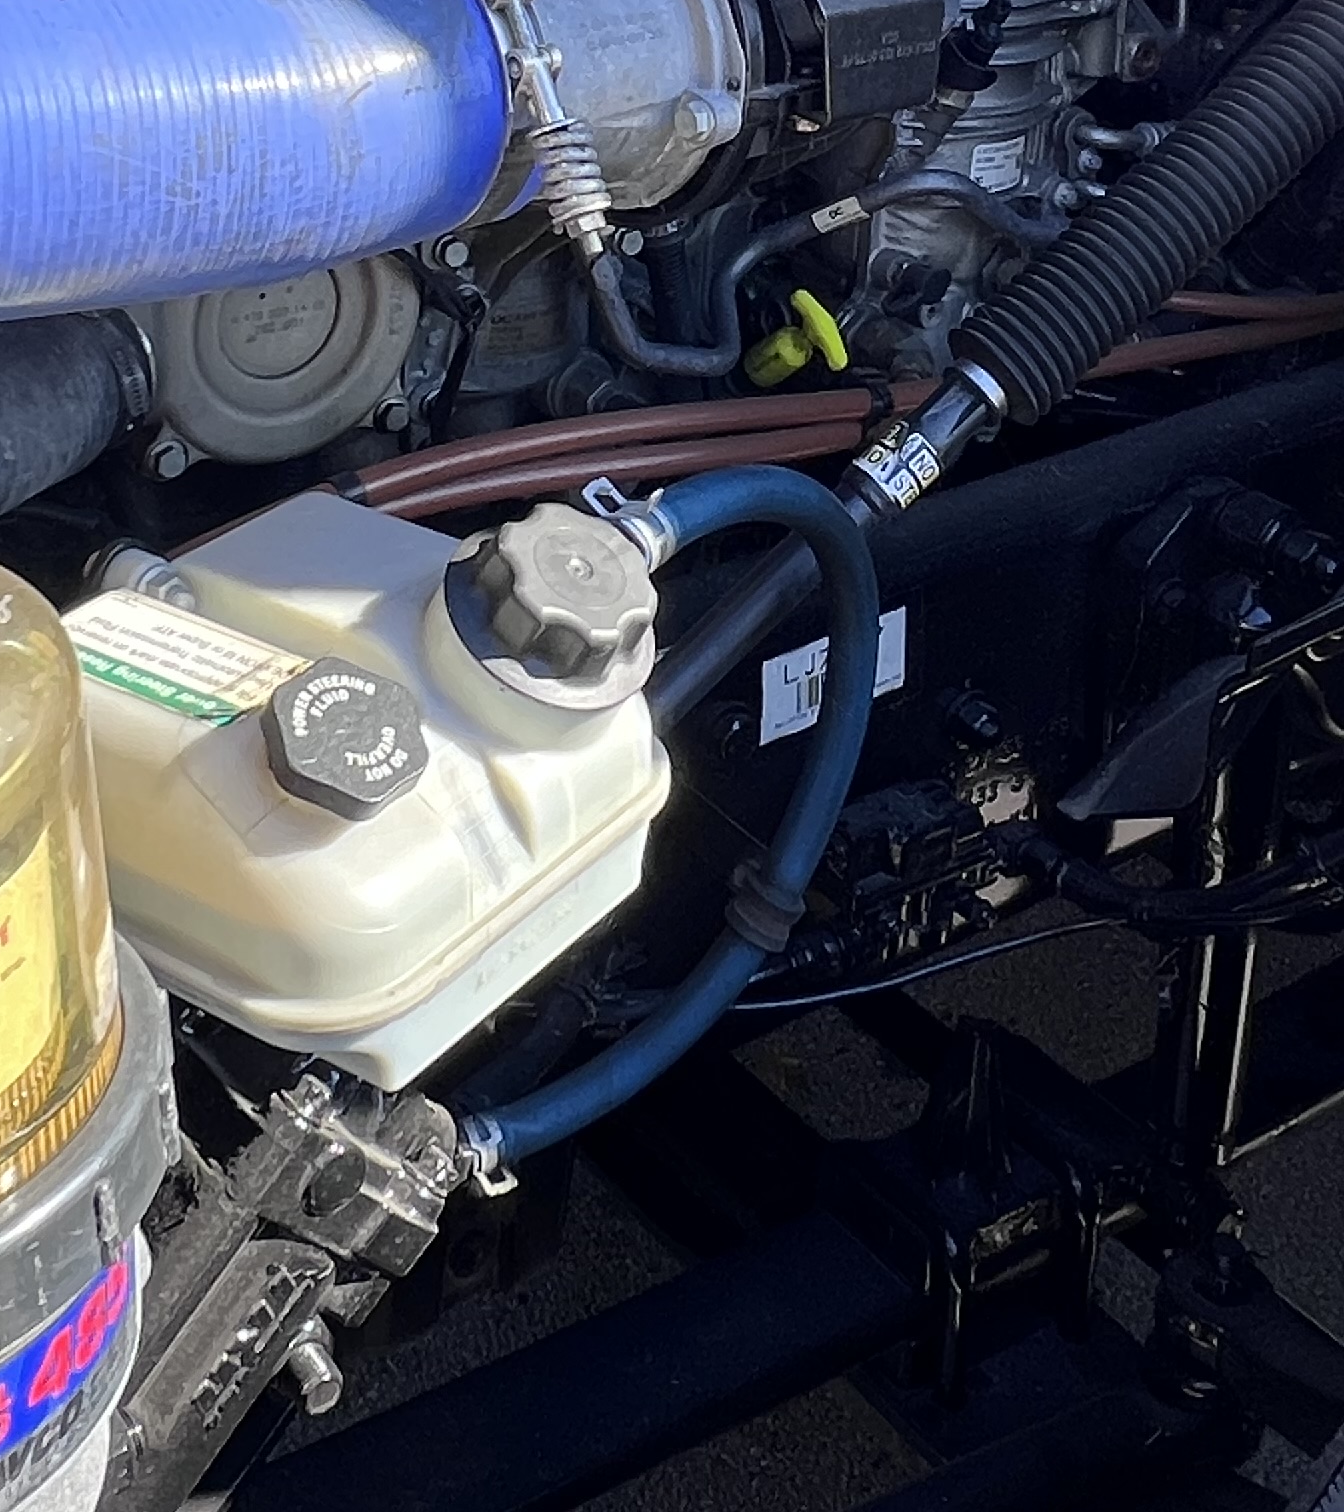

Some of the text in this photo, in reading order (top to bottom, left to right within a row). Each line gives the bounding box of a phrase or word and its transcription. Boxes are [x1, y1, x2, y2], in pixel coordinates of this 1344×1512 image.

[112, 665, 177, 700] Steering
[292, 674, 376, 738] POWER STEERING
[309, 688, 350, 718] FLUID
[344, 726, 396, 766] OVERFILL
[365, 748, 409, 783] DO NOT
